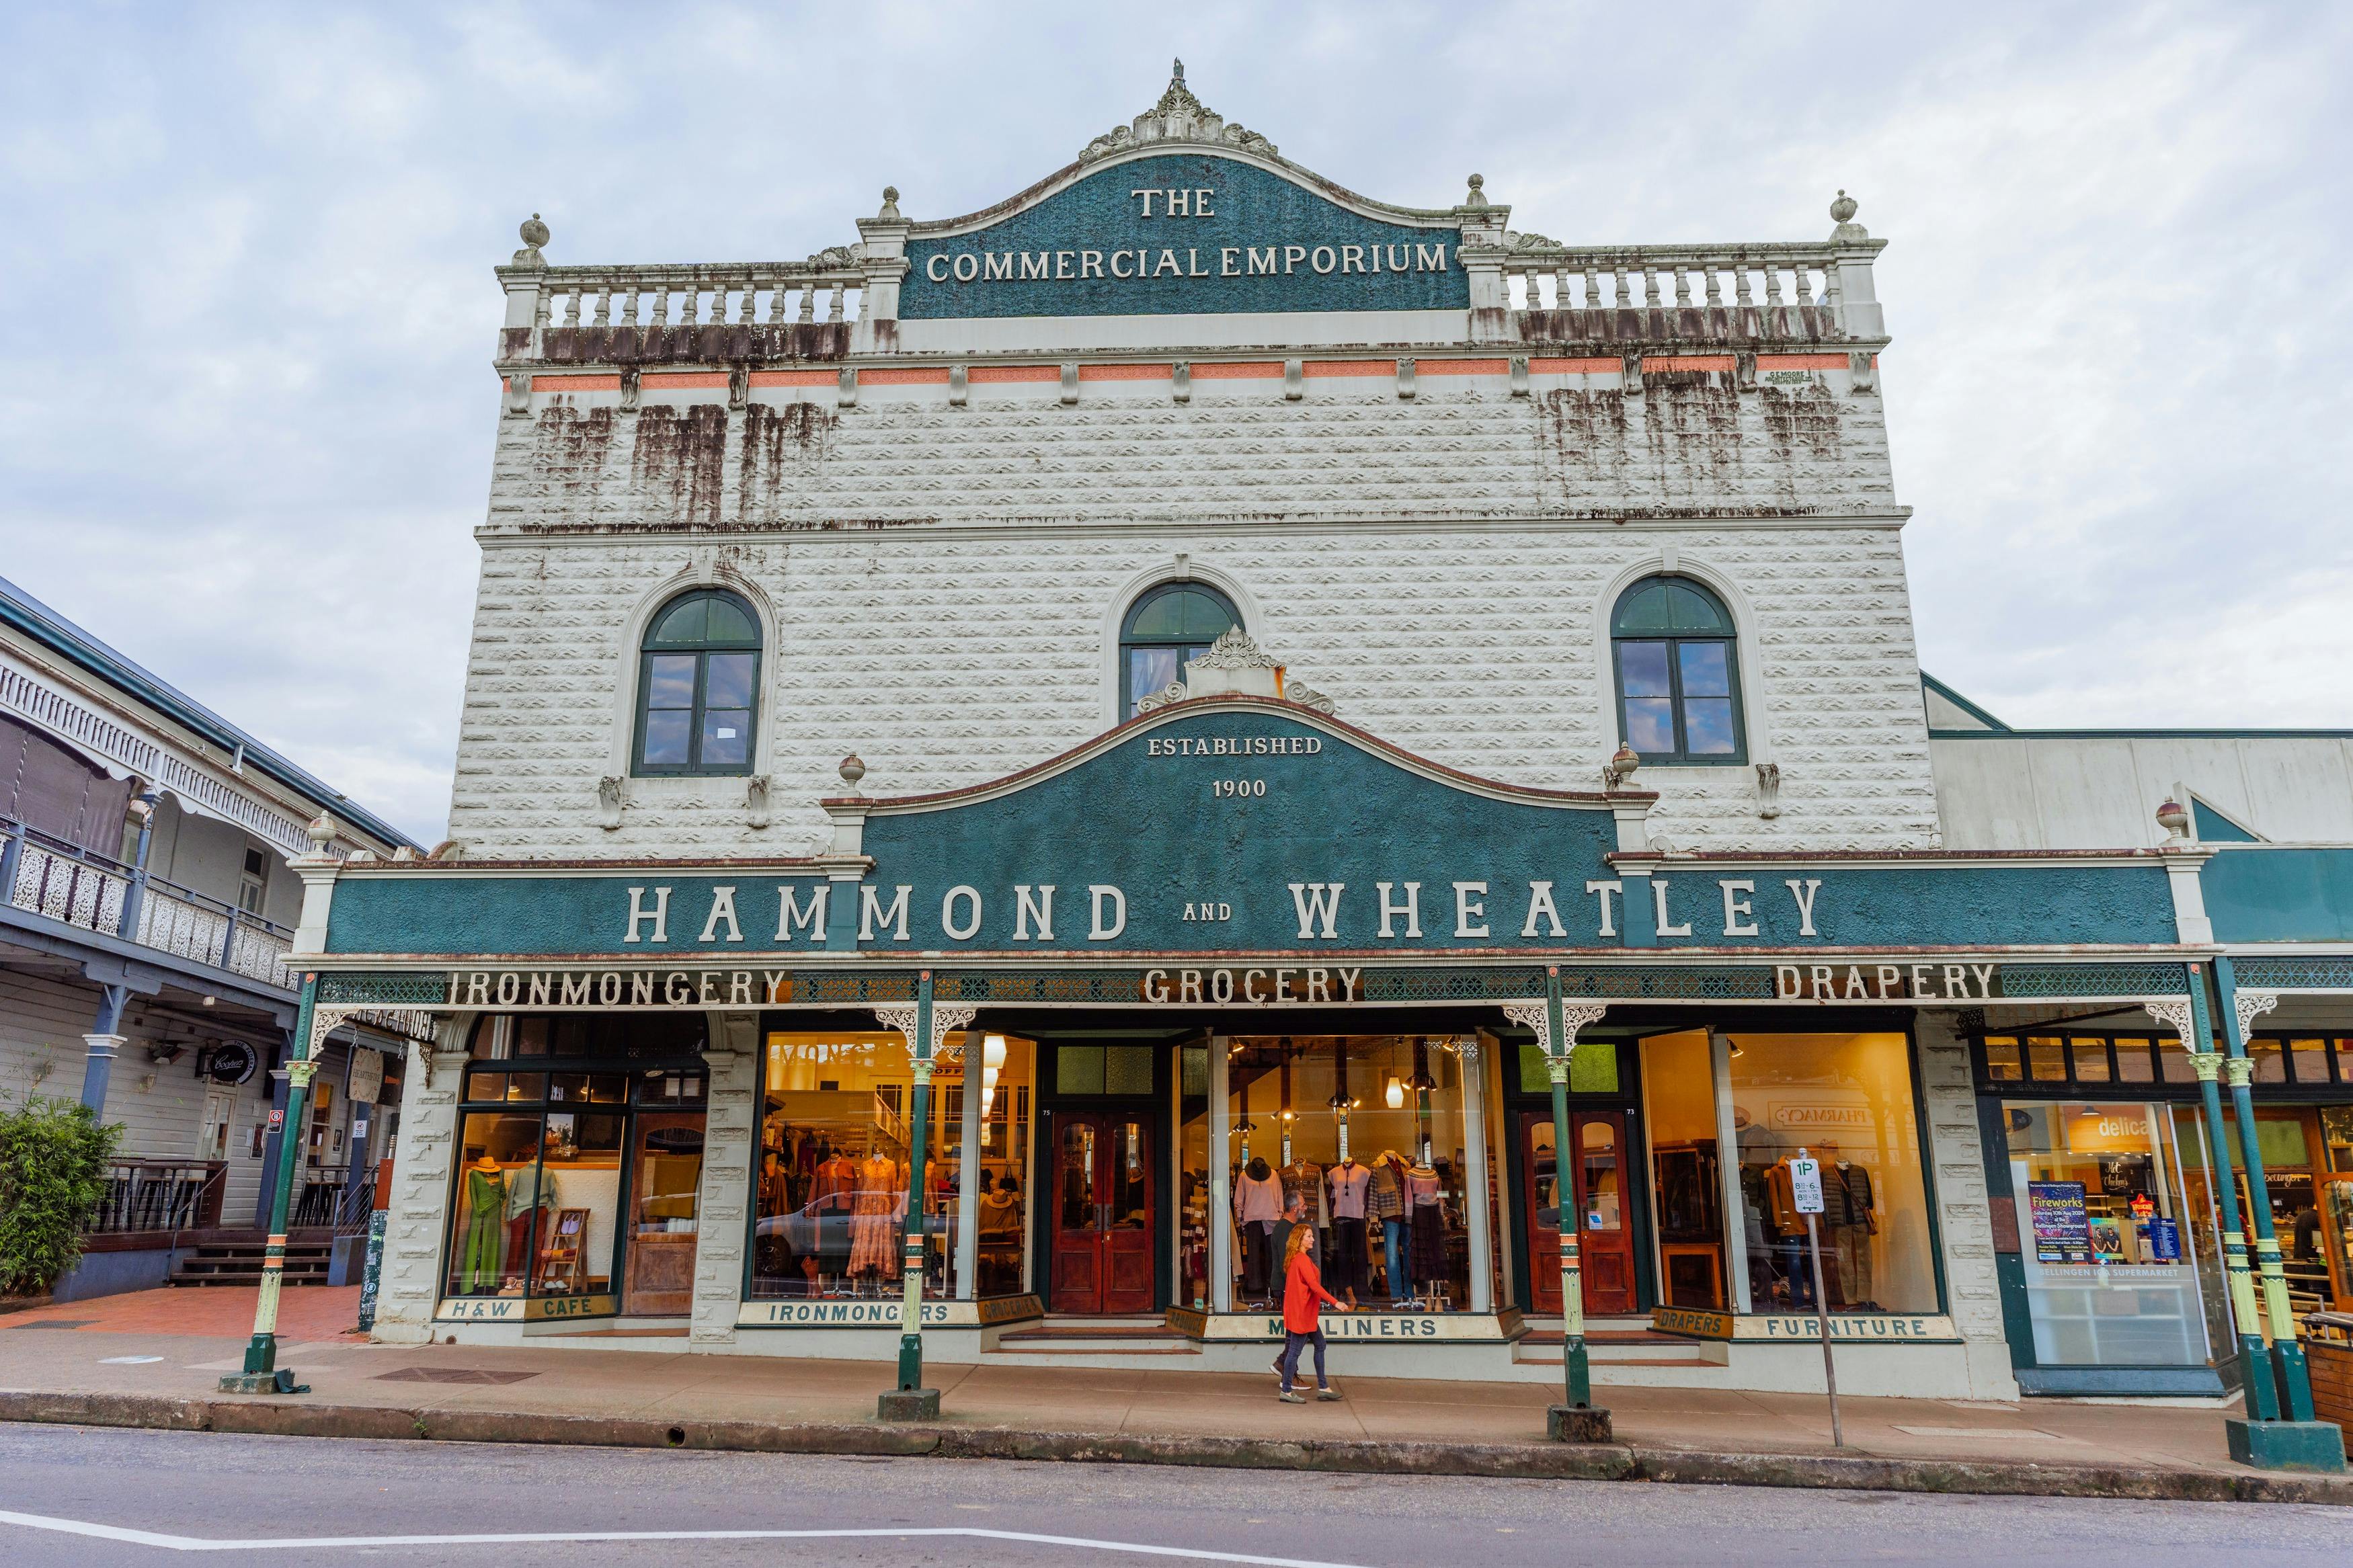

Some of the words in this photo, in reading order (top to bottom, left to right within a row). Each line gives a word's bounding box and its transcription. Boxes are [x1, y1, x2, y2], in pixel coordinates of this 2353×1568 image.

[1131, 188, 1215, 217] THE
[926, 247, 1209, 283] COMMERCIAL
[1220, 243, 1447, 277] EMPORIUM
[1148, 737, 1322, 755] ESTABLISHED
[1213, 779, 1266, 797] 1900
[623, 884, 1127, 942] HAMMOND
[1183, 903, 1231, 921] AND
[1287, 878, 1822, 940] WHEATLEY
[449, 969, 785, 1005] IRONMONGERY
[1144, 967, 1361, 1003] GROCERY
[1776, 964, 1995, 999] DRAPERY
[353, 1069, 381, 1082] HEARTHFIRE
[1797, 1163, 1812, 1175] 1P
[2032, 1196, 2083, 1208] Fireworks
[2039, 1268, 2090, 1276] BELLINGEN
[2113, 1269, 2178, 1277] SUPERMARKET
[452, 1302, 468, 1317] H
[472, 1302, 485, 1317] &
[491, 1302, 512, 1317] W
[769, 1305, 947, 1321] IRONMONGRS
[984, 1298, 1037, 1318] GROCERIES
[1169, 1312, 1204, 1333] PRODUCE
[1269, 1319, 1436, 1335] MLINERS
[1659, 1311, 1722, 1334] DRAPERS
[1767, 1319, 1927, 1336] FURNITURE
